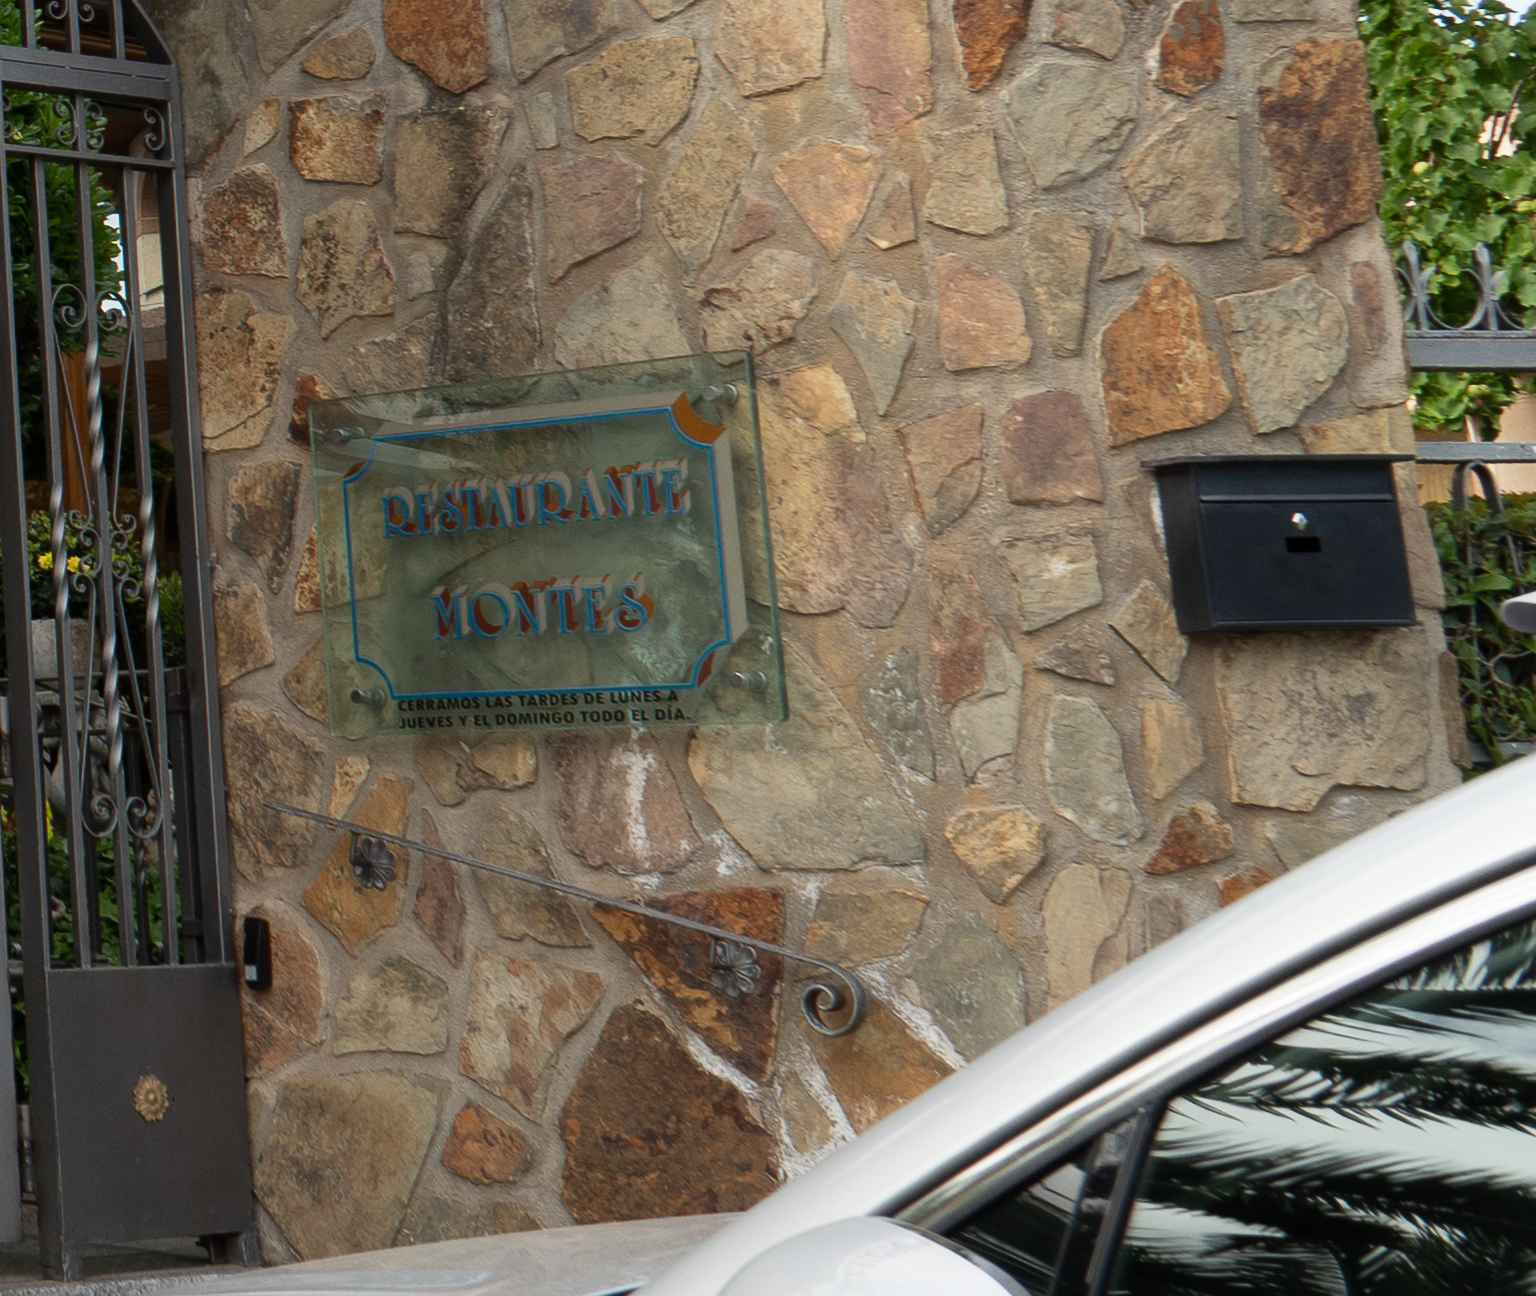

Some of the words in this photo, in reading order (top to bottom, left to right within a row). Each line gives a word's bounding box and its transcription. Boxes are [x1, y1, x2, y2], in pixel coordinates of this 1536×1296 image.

[380, 462, 690, 539] RESTAURANTE
[431, 578, 652, 641] MONTES
[398, 697, 479, 712] CERRAMOS
[485, 694, 512, 709] LAS
[519, 693, 578, 708] TARDES
[584, 692, 603, 704] DE
[610, 690, 661, 704] LUNES
[667, 690, 679, 702] A
[399, 715, 453, 729] JUEVES
[458, 715, 468, 728] Y
[474, 714, 491, 727] EL
[496, 711, 575, 726] DOMINGO
[580, 709, 625, 724] TODO
[631, 708, 649, 722] EL
[655, 706, 691, 722] DÍA.
